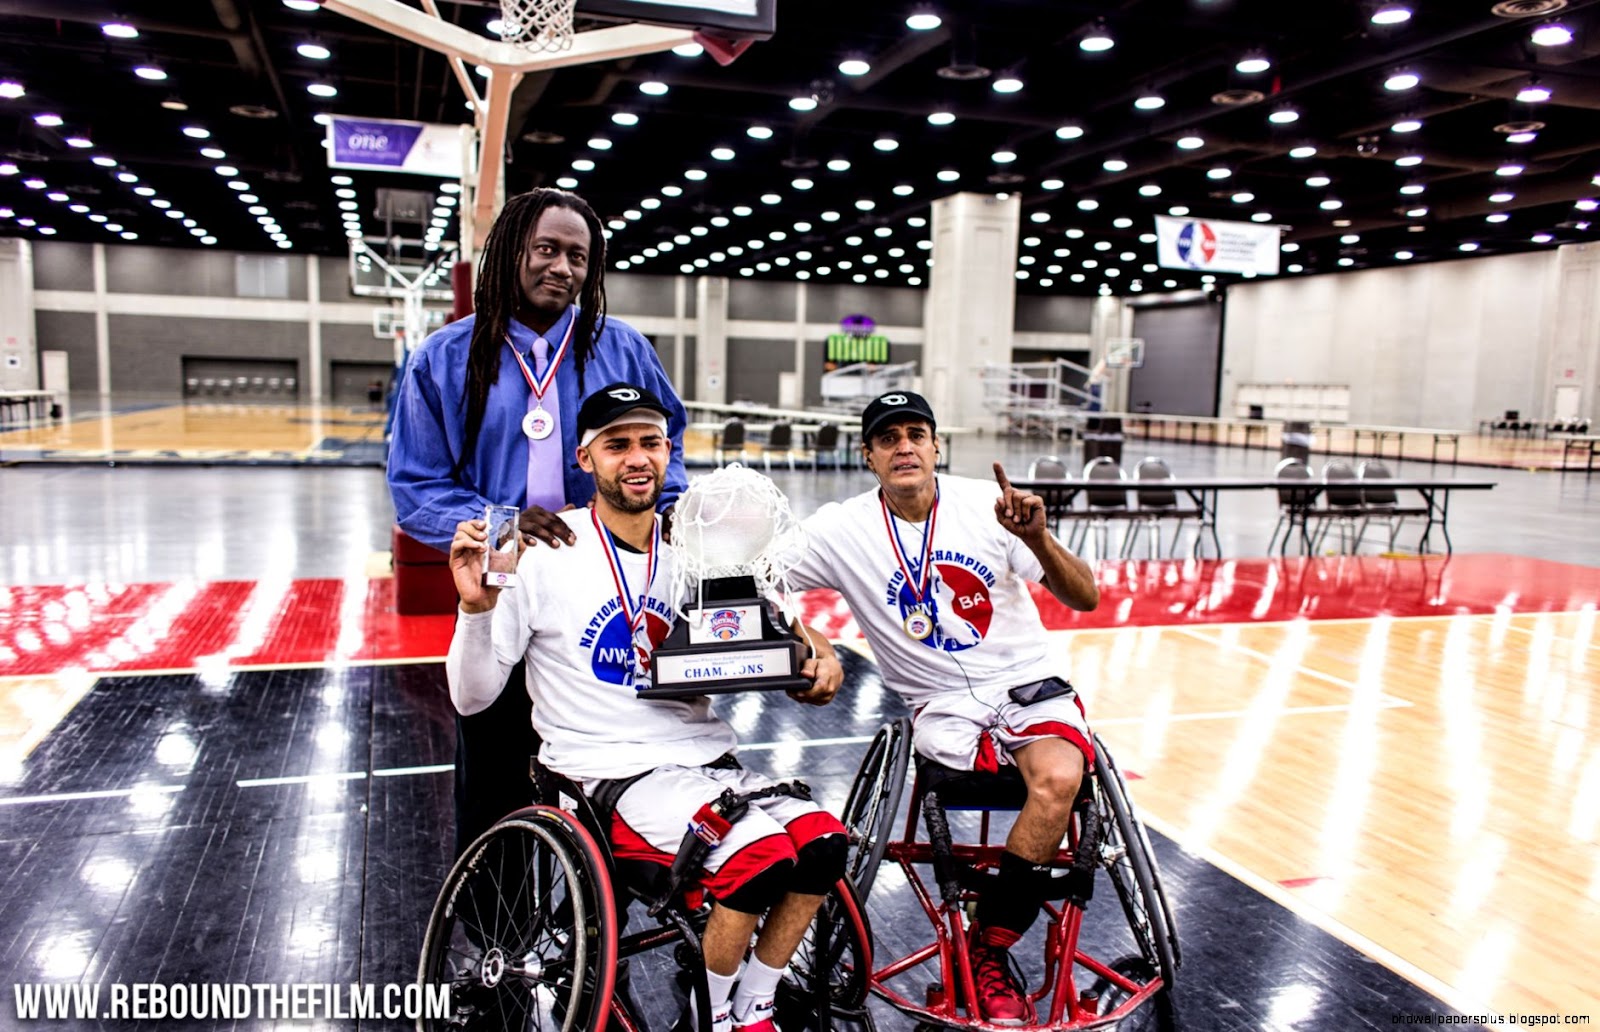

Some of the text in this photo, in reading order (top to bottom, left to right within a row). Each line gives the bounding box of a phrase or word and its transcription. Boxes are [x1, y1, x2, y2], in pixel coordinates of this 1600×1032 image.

[348, 134, 389, 151] one
[958, 592, 986, 610] BA
[579, 595, 673, 649] NATIONA CHAM
[684, 663, 764, 679] CHAMONS
